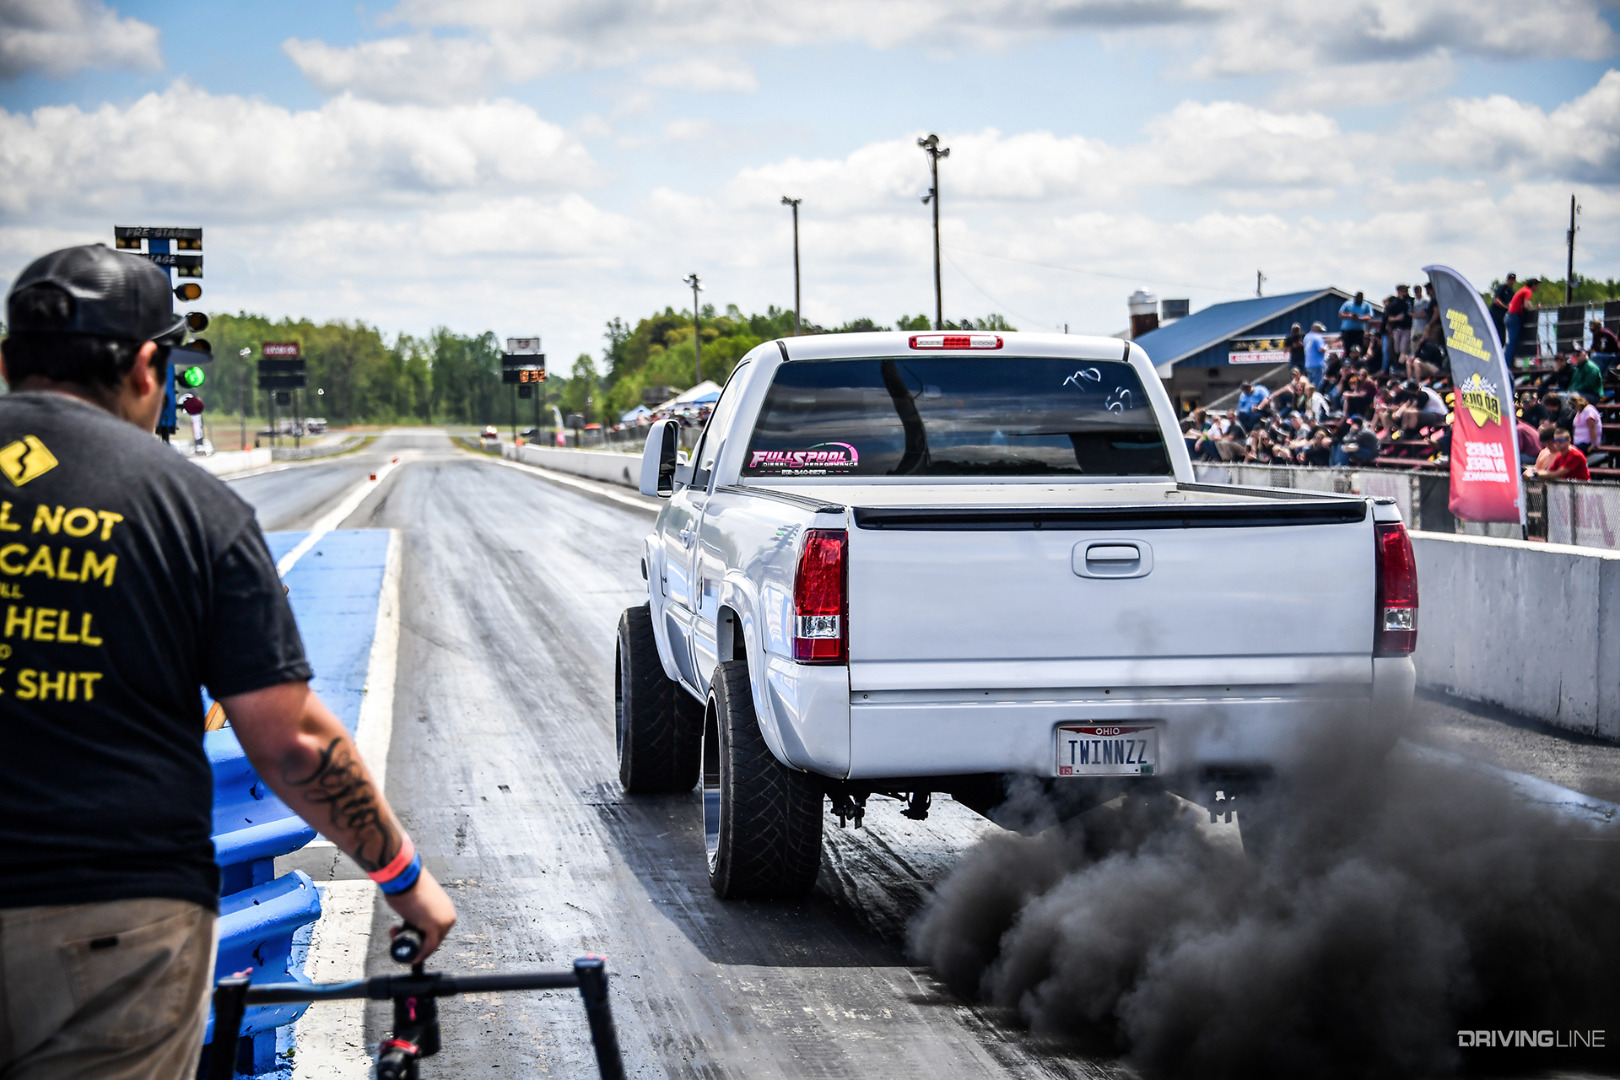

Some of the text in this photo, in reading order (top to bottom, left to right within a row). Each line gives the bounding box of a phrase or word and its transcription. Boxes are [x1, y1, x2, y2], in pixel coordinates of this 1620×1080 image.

[147, 255, 177, 265] TAGE
[31, 504, 124, 541] NOT
[0, 543, 118, 587] CALM
[4, 605, 103, 646] HELL
[16, 668, 103, 701] SHIT
[1095, 727, 1120, 736] OHIO
[1068, 740, 1147, 765] TWINNZZ
